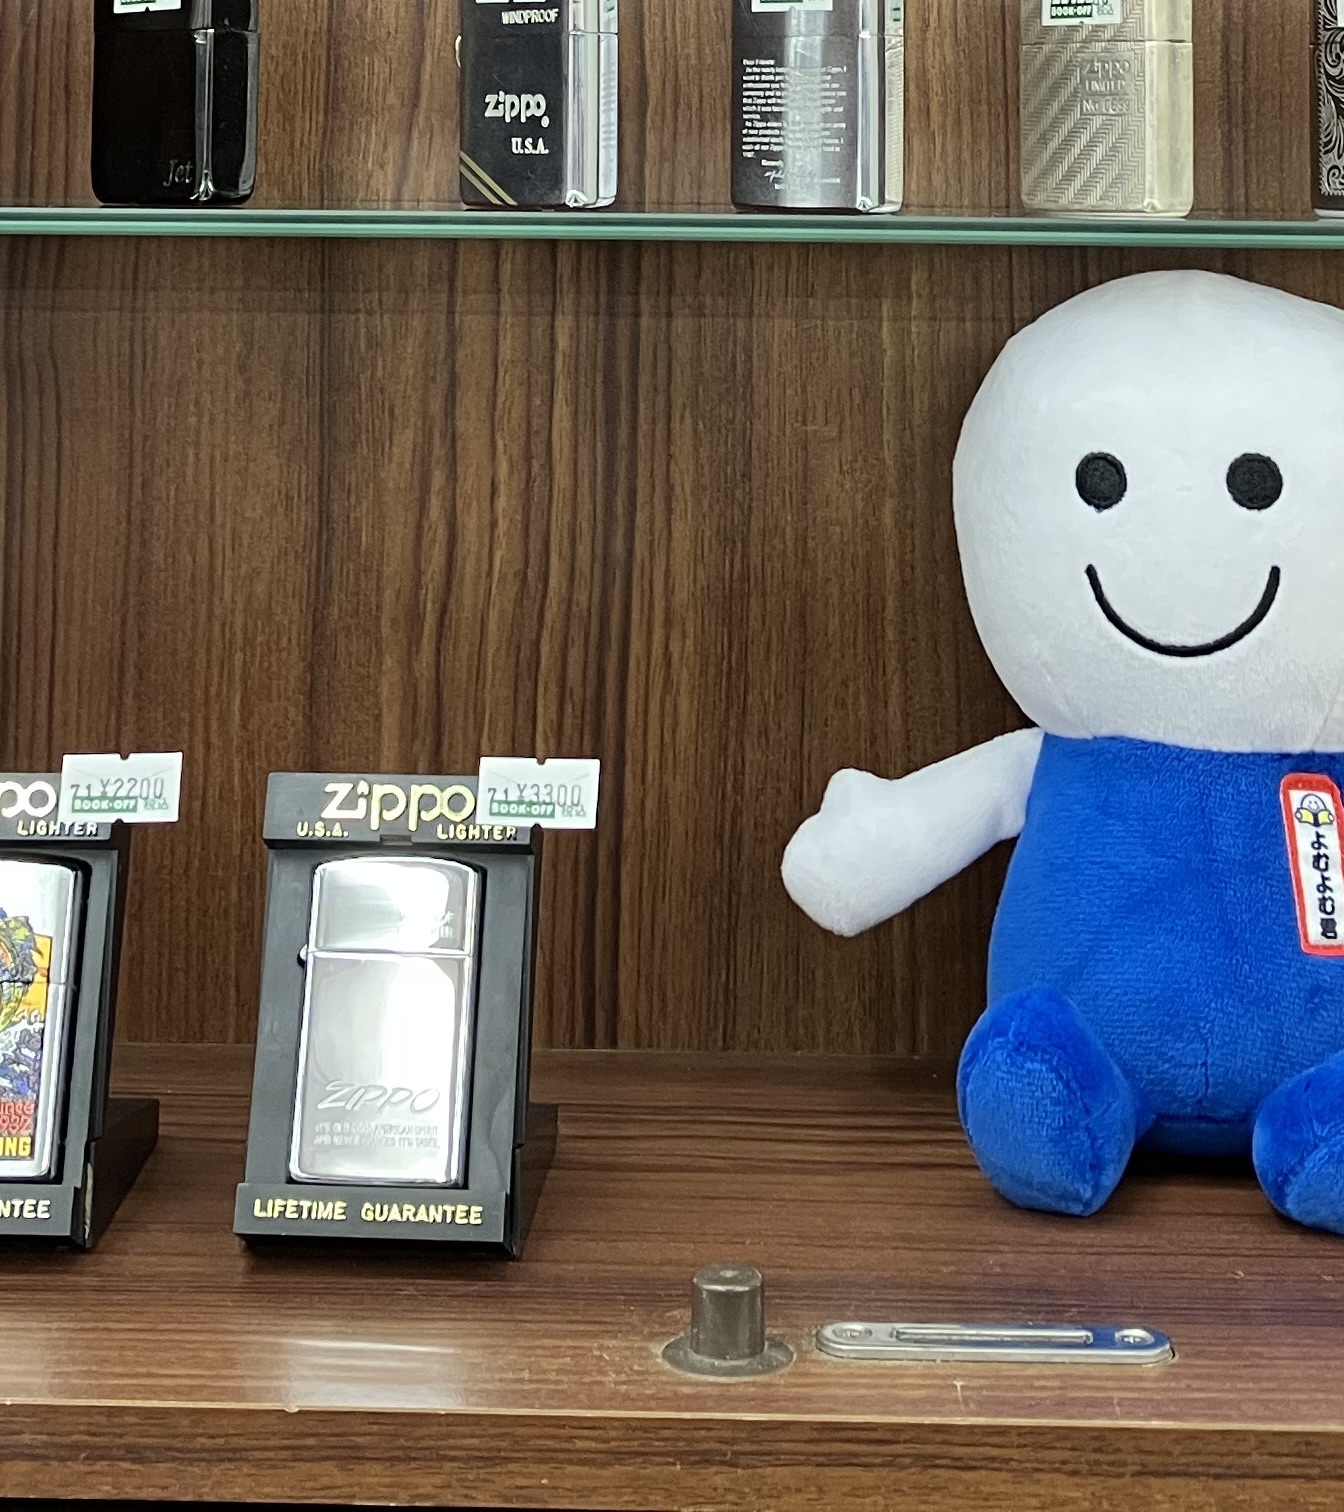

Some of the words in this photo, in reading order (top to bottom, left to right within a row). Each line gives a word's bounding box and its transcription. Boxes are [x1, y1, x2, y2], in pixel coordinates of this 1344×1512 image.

[501, 8, 559, 25] WINDPROOF
[71, 784, 92, 797] 71
[100, 778, 164, 800] ¥2200
[487, 788, 509, 801] 71
[517, 784, 581, 807] ¥3300
[17, 820, 98, 836] LIGHTER
[297, 821, 349, 837] U.S.A.
[437, 823, 517, 841] LIGHTER
[253, 1199, 347, 1220] LIFETIME
[360, 1202, 484, 1225] GUARANTEE
